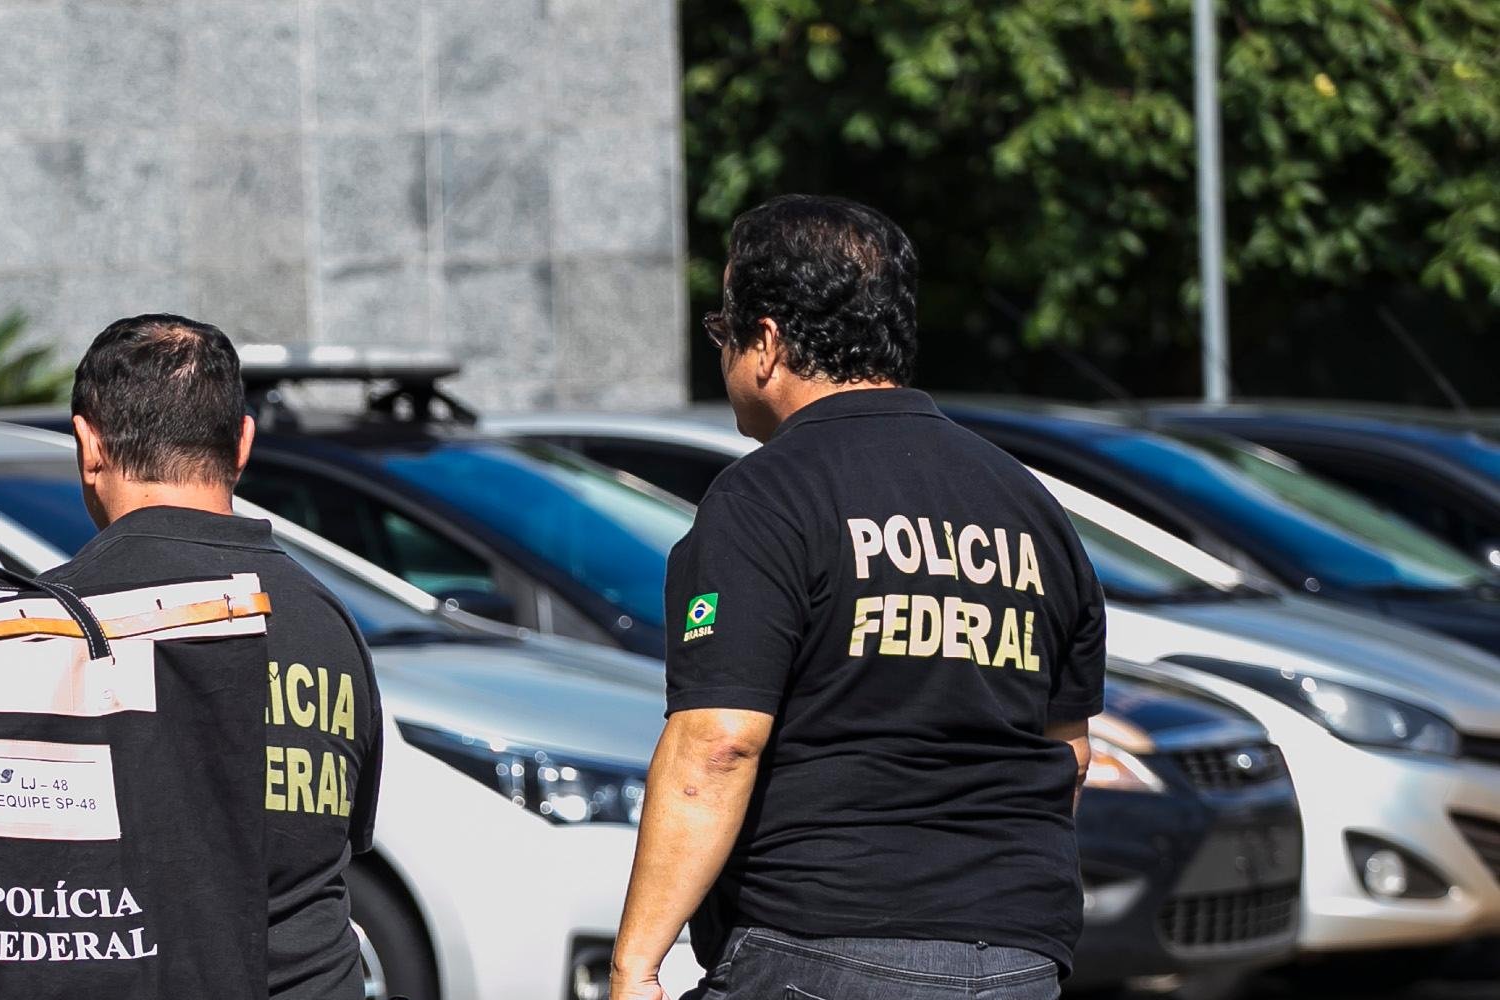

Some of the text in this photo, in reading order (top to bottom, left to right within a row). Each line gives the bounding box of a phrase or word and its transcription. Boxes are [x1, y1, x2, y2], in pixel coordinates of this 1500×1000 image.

[683, 625, 715, 642] BRASIL
[848, 593, 1041, 672] FEDERAL
[20, 777, 37, 790] LJ
[52, 779, 69, 792] 48
[265, 745, 351, 818] ERAL
[55, 797, 97, 811] SP-48
